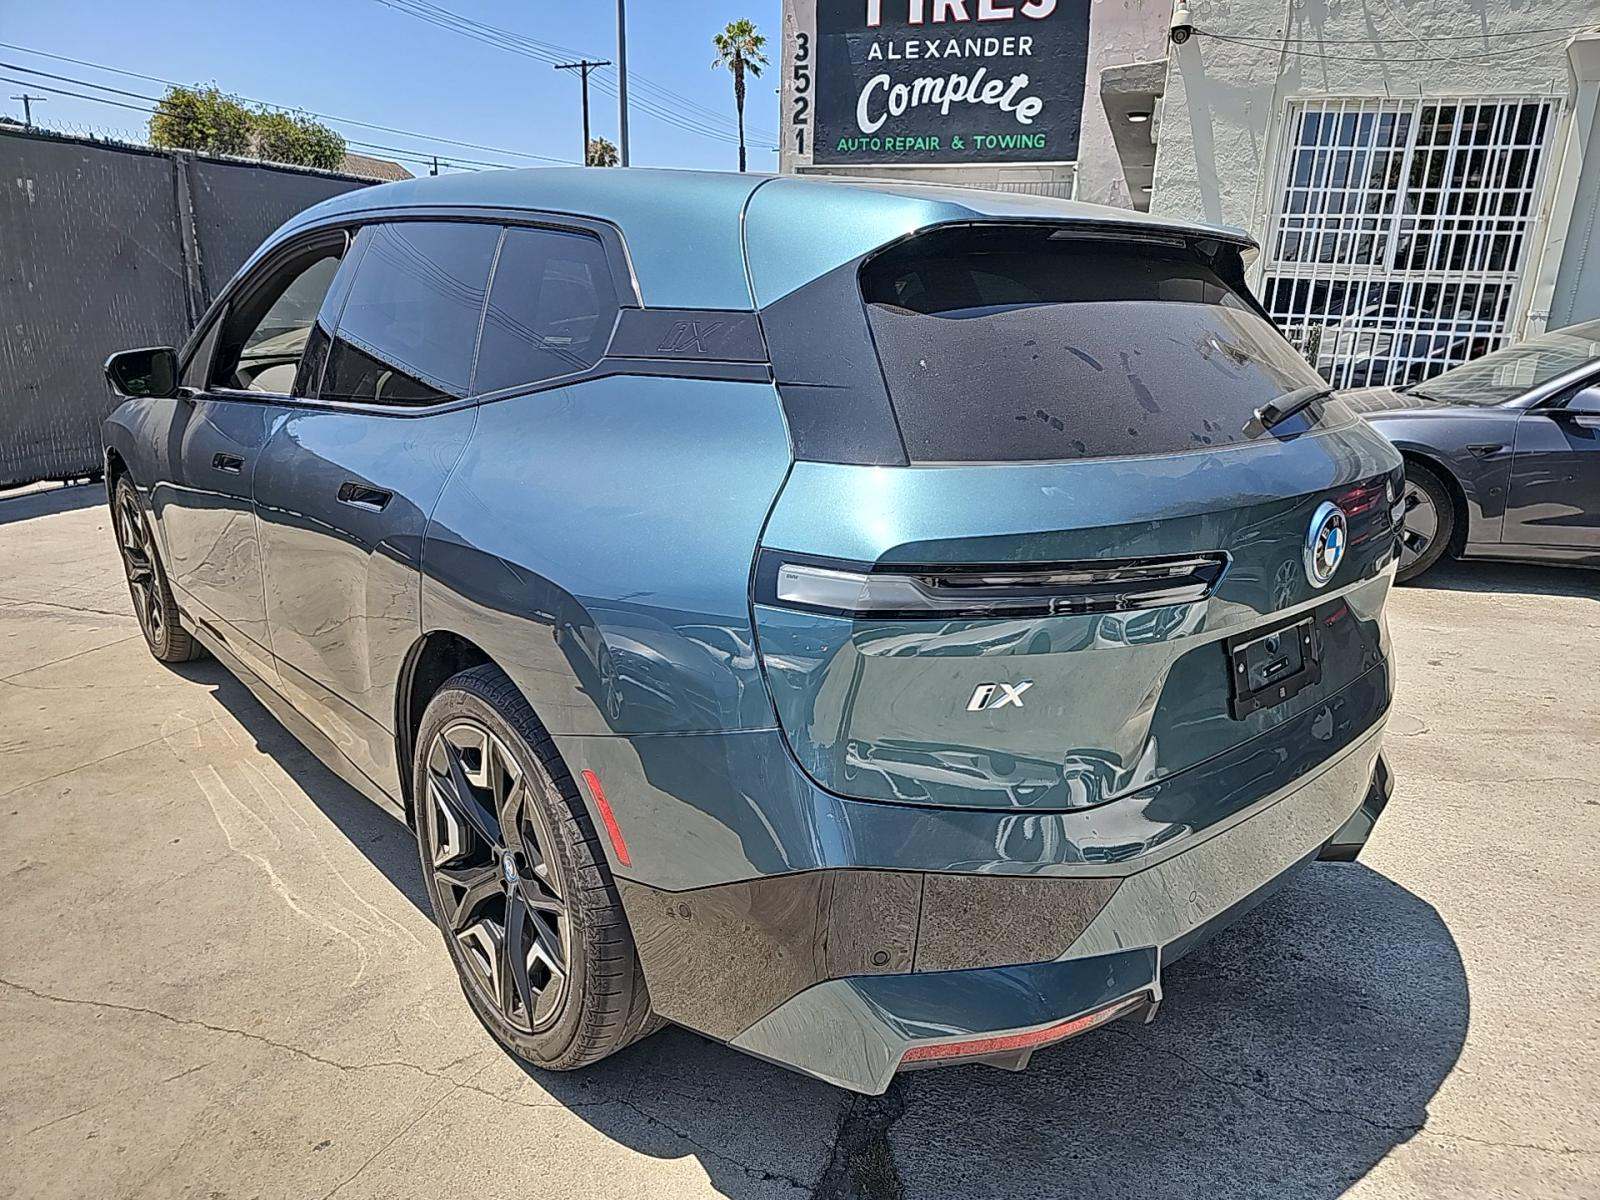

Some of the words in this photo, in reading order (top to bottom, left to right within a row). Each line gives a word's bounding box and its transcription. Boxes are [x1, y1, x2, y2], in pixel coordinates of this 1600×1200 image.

[867, 36, 1033, 60] ALEXANDER
[793, 33, 810, 154] 3521
[857, 67, 1043, 134] Complete
[837, 137, 881, 151] AUTO
[884, 136, 940, 151] REPAIR
[951, 136, 965, 149] &
[973, 134, 1046, 149] TOWING
[965, 680, 1034, 711] iX
